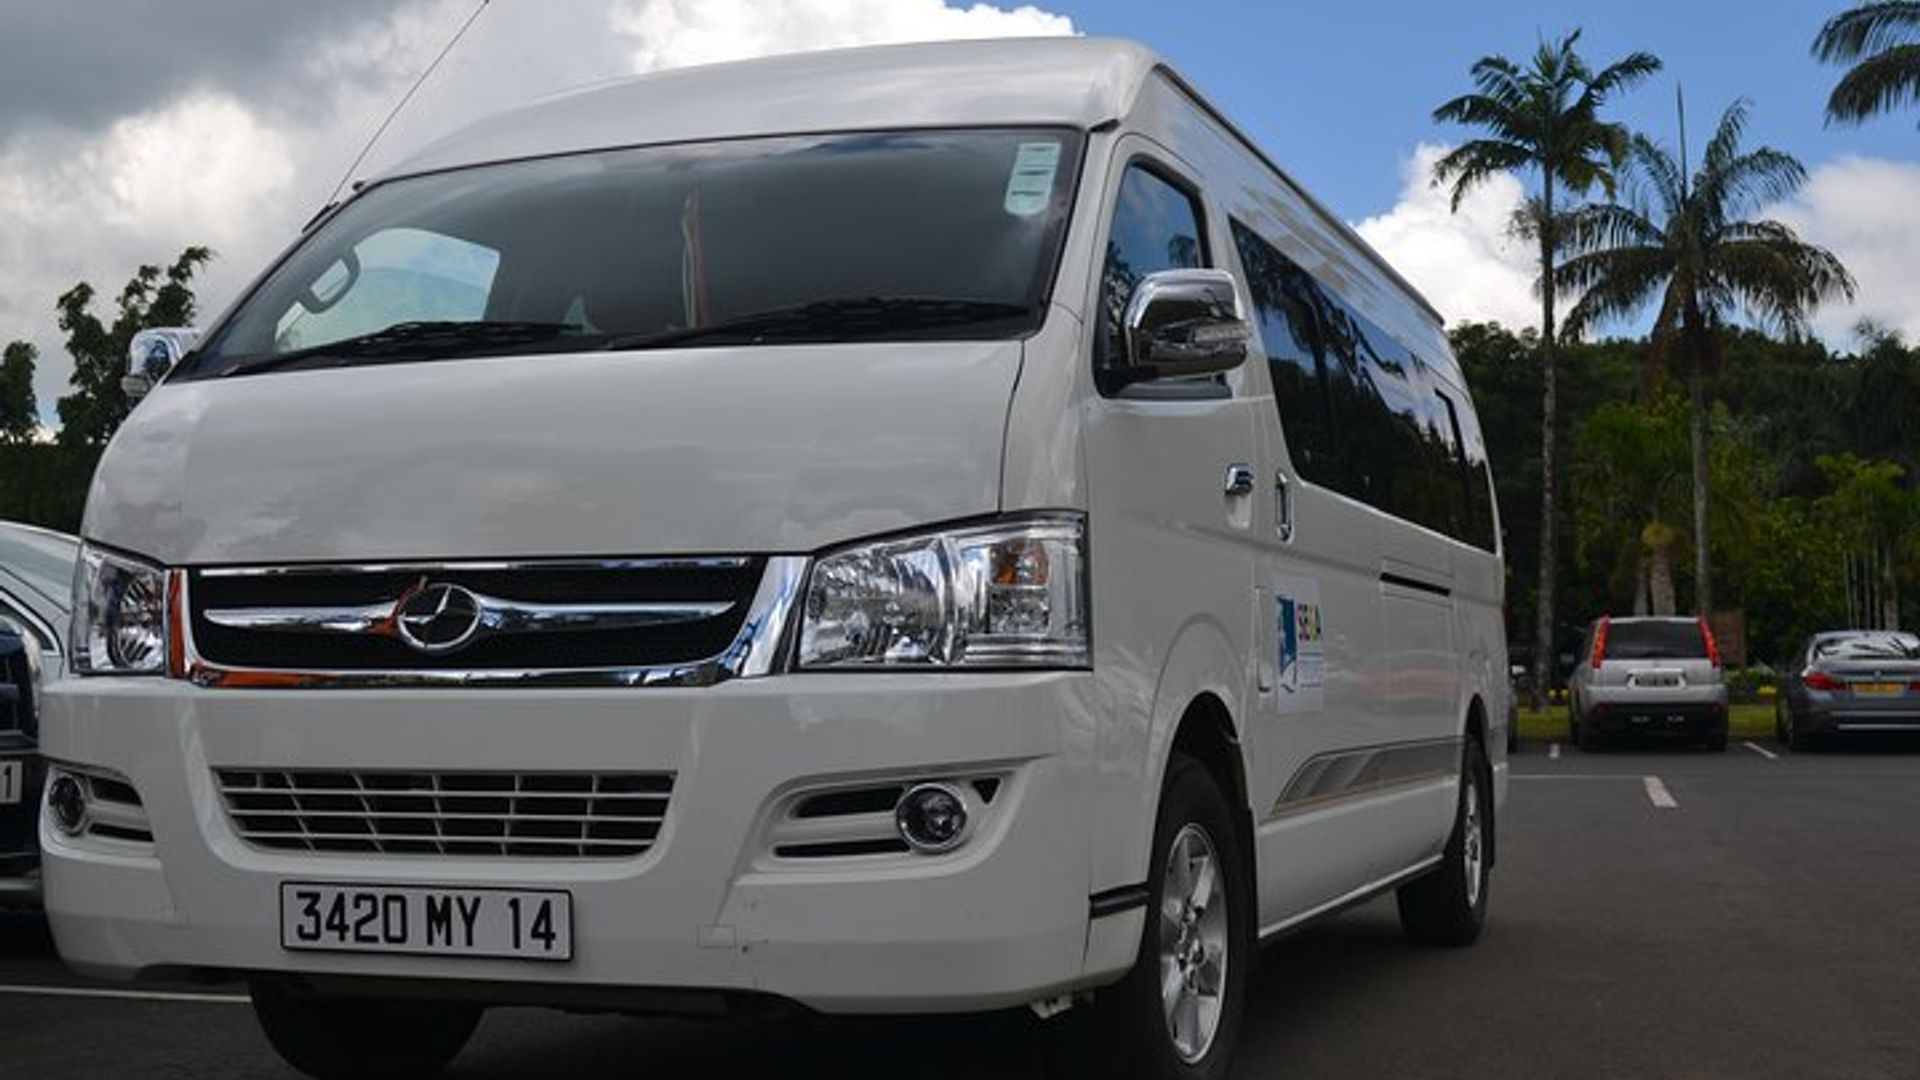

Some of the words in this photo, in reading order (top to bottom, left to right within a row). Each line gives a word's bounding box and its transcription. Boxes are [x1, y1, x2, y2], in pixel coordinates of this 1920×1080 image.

[297, 892, 407, 944] 3420
[426, 895, 481, 946] MY
[508, 898, 556, 950] 14
